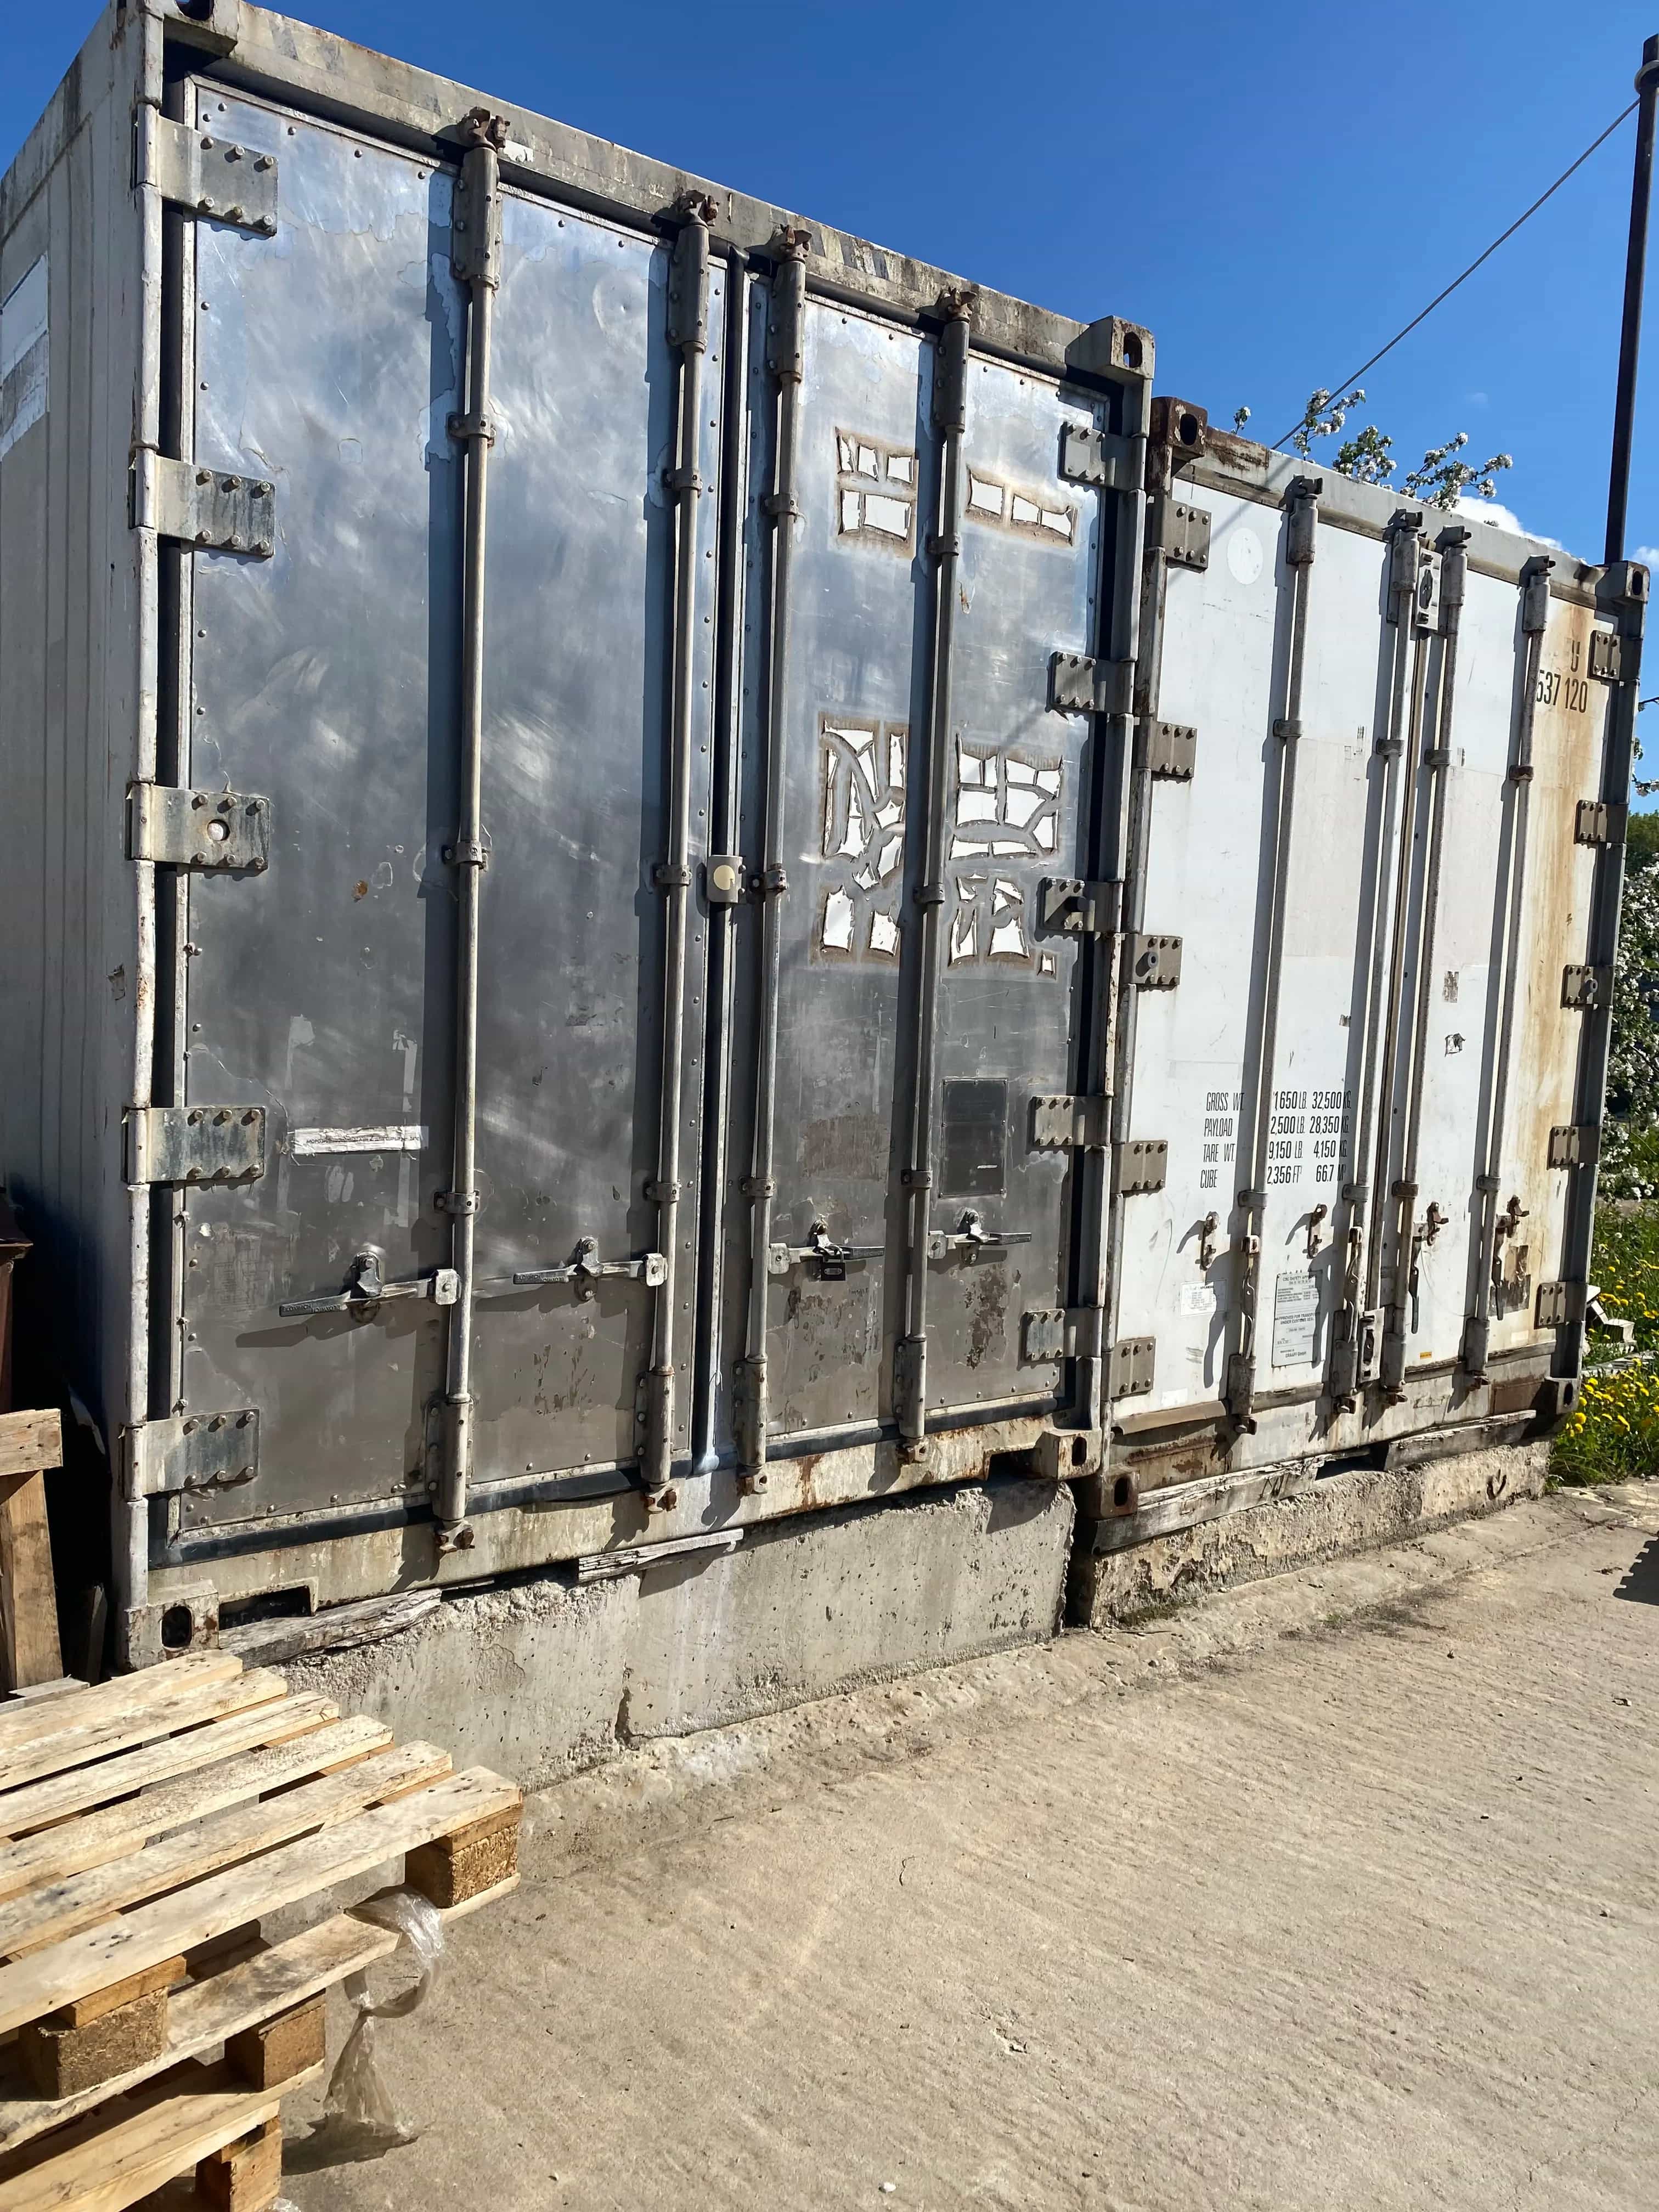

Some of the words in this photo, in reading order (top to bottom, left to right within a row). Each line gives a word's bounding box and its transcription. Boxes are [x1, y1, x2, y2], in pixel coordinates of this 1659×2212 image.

[1536, 670, 1561, 706] 537
[1565, 678, 1588, 713] 120
[1206, 1092, 1229, 1111] GROSS
[1273, 1091, 1298, 1111] 1,650
[1299, 1091, 1307, 1109] LB.
[1312, 1091, 1342, 1110] 32,500
[1204, 1118, 1233, 1137] PAYLOAD
[1296, 1116, 1305, 1134] LB.
[1309, 1115, 1340, 1135] 28,350
[1203, 1143, 1220, 1163] TARE
[1224, 1143, 1236, 1162] WT.
[1268, 1141, 1292, 1161] 9,150
[1294, 1141, 1303, 1159] LB.
[1313, 1140, 1336, 1159] 4,150
[1200, 1169, 1218, 1189] CUBE
[1267, 1165, 1291, 1185] 2,356
[1316, 1164, 1334, 1182] 66.7
